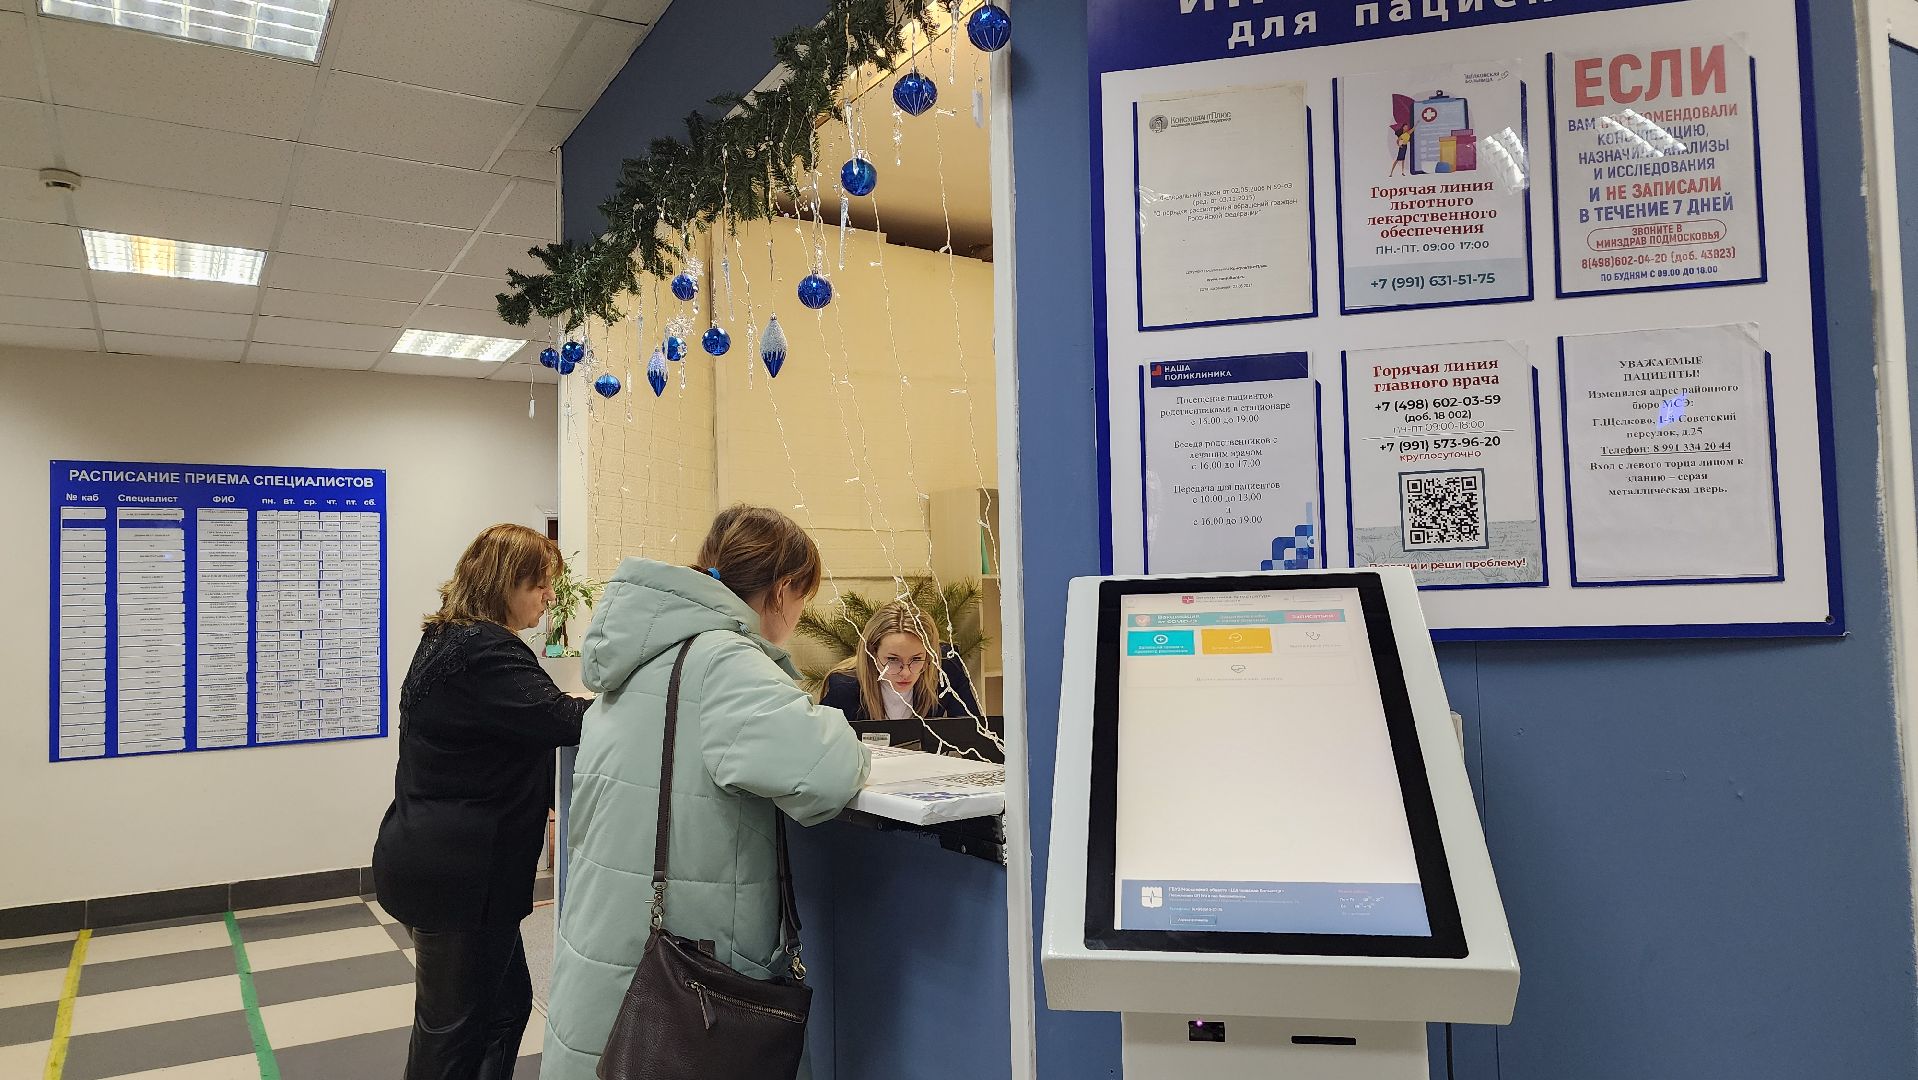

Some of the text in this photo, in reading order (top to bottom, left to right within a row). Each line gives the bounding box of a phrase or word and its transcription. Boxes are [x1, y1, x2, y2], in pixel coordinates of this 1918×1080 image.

[1228, 0, 1551, 50] для паци
[1575, 45, 1726, 108] ЕСЛИ
[1568, 119, 1596, 131] ВАМ
[1594, 158, 1715, 180] И ИССЛЕДОВАНИЯ
[1371, 182, 1494, 199] Горячая линия
[1590, 176, 1722, 202] И НЕ ЗАПИСАЛИ
[1390, 197, 1474, 210] льготного
[1579, 192, 1734, 223] В ТЕЧЕНИЕ 7 ДНЕЙ
[1368, 210, 1497, 226] лекарственного
[1381, 224, 1484, 238] обеспечения
[1632, 224, 1683, 236] ЗВОНИТЕ В
[1596, 231, 1720, 249] МИНЗДРАВ ПОДМОСКОВЬЯ
[1376, 241, 1489, 255] ПН.-ПТ. 09:00 17:00
[1582, 253, 1667, 269] 8(498)602-04-20
[1672, 251, 1698, 264] (доб.
[1601, 265, 1718, 282] ПО БУДНЯМ С 09.00 ДО 18.00
[1371, 273, 1495, 291] +7 (991) 631-51-75
[1164, 364, 1191, 373] НАША
[1619, 356, 1703, 369] УВАЖАЕМЫЕ
[1164, 371, 1232, 381] ПОЛИКЛИНИКА
[1373, 360, 1498, 379] Горячая линия
[1624, 369, 1700, 382] ПАЦИЕНТЫ!
[1374, 374, 1500, 392] главного врача
[1227, 392, 1274, 402] пациентов
[1588, 385, 1739, 399] Изменился адрес районного
[1241, 403, 1291, 413] стационаре
[1374, 395, 1501, 413] +7 (498) 602-03-59
[1632, 399, 1694, 410] бюро МСЭ:
[1236, 415, 1259, 423] 19.00
[1405, 409, 1472, 423] (доб. 18 002)
[1679, 412, 1737, 423] Советский
[1682, 427, 1703, 437] д.25
[1379, 436, 1501, 453] +7 (991) 573-96-20
[1601, 442, 1732, 456] Телефон: 8 991 334 20 44
[1400, 451, 1482, 462] круглосуточно
[1199, 461, 1222, 469] 16.00
[1590, 462, 1615, 471] Вход
[1626, 462, 1662, 470] левого
[1665, 460, 1696, 469] торца
[69, 470, 374, 488] РАСПИСАНИЕ ПРИЕМА СПЕЦИАЛИСТОВ
[1678, 473, 1708, 482] серая
[1174, 485, 1215, 494] Передача
[1235, 482, 1281, 491] пациентов
[1609, 486, 1691, 496] металлическая
[66, 493, 99, 502] № каб
[118, 494, 178, 503] Специалист
[213, 495, 235, 504] ФИО
[1200, 495, 1223, 503] 10.00
[1239, 493, 1262, 502] 13.00
[1201, 517, 1224, 526] 16.00
[1226, 518, 1237, 526] до
[1239, 515, 1263, 524] 19.00
[1431, 562, 1462, 572] реши
[1466, 558, 1526, 570] проблему!
